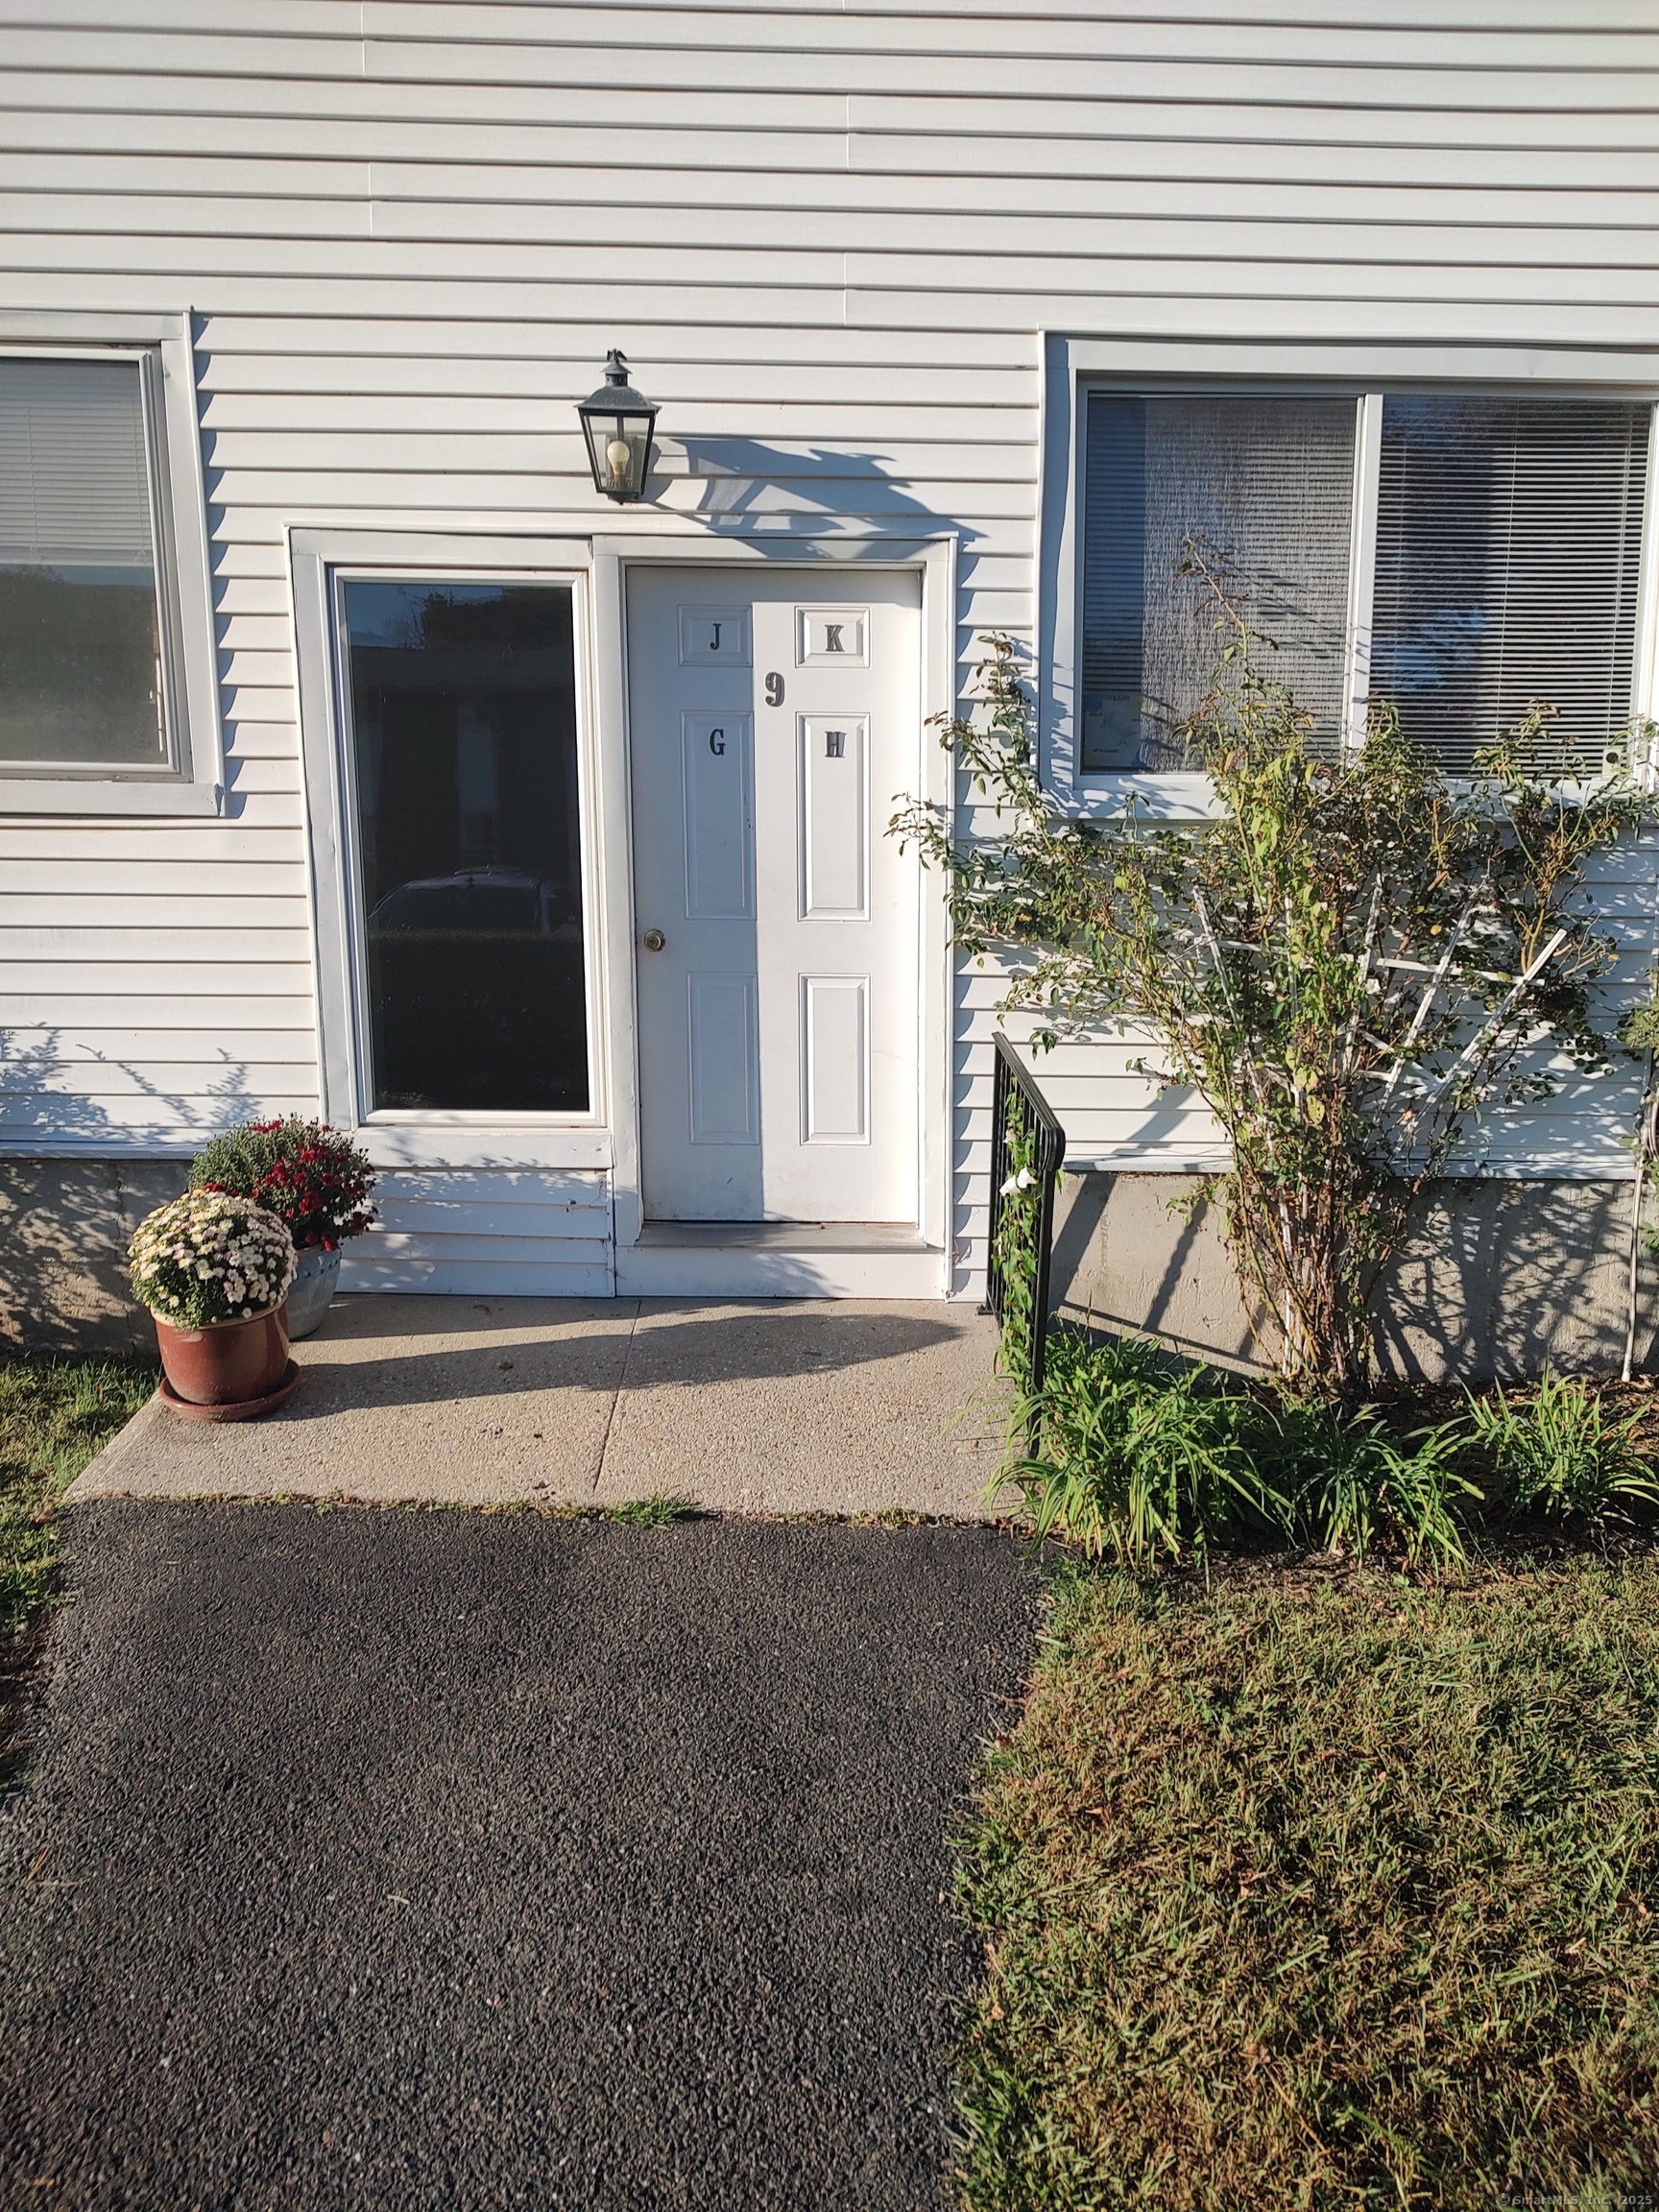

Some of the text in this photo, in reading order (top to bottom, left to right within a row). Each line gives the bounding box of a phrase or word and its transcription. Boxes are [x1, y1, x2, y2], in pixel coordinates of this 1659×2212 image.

[709, 623, 722, 650] J
[824, 624, 845, 652] K
[764, 671, 785, 708] 9
[709, 728, 726, 756] G
[825, 731, 847, 758] H
